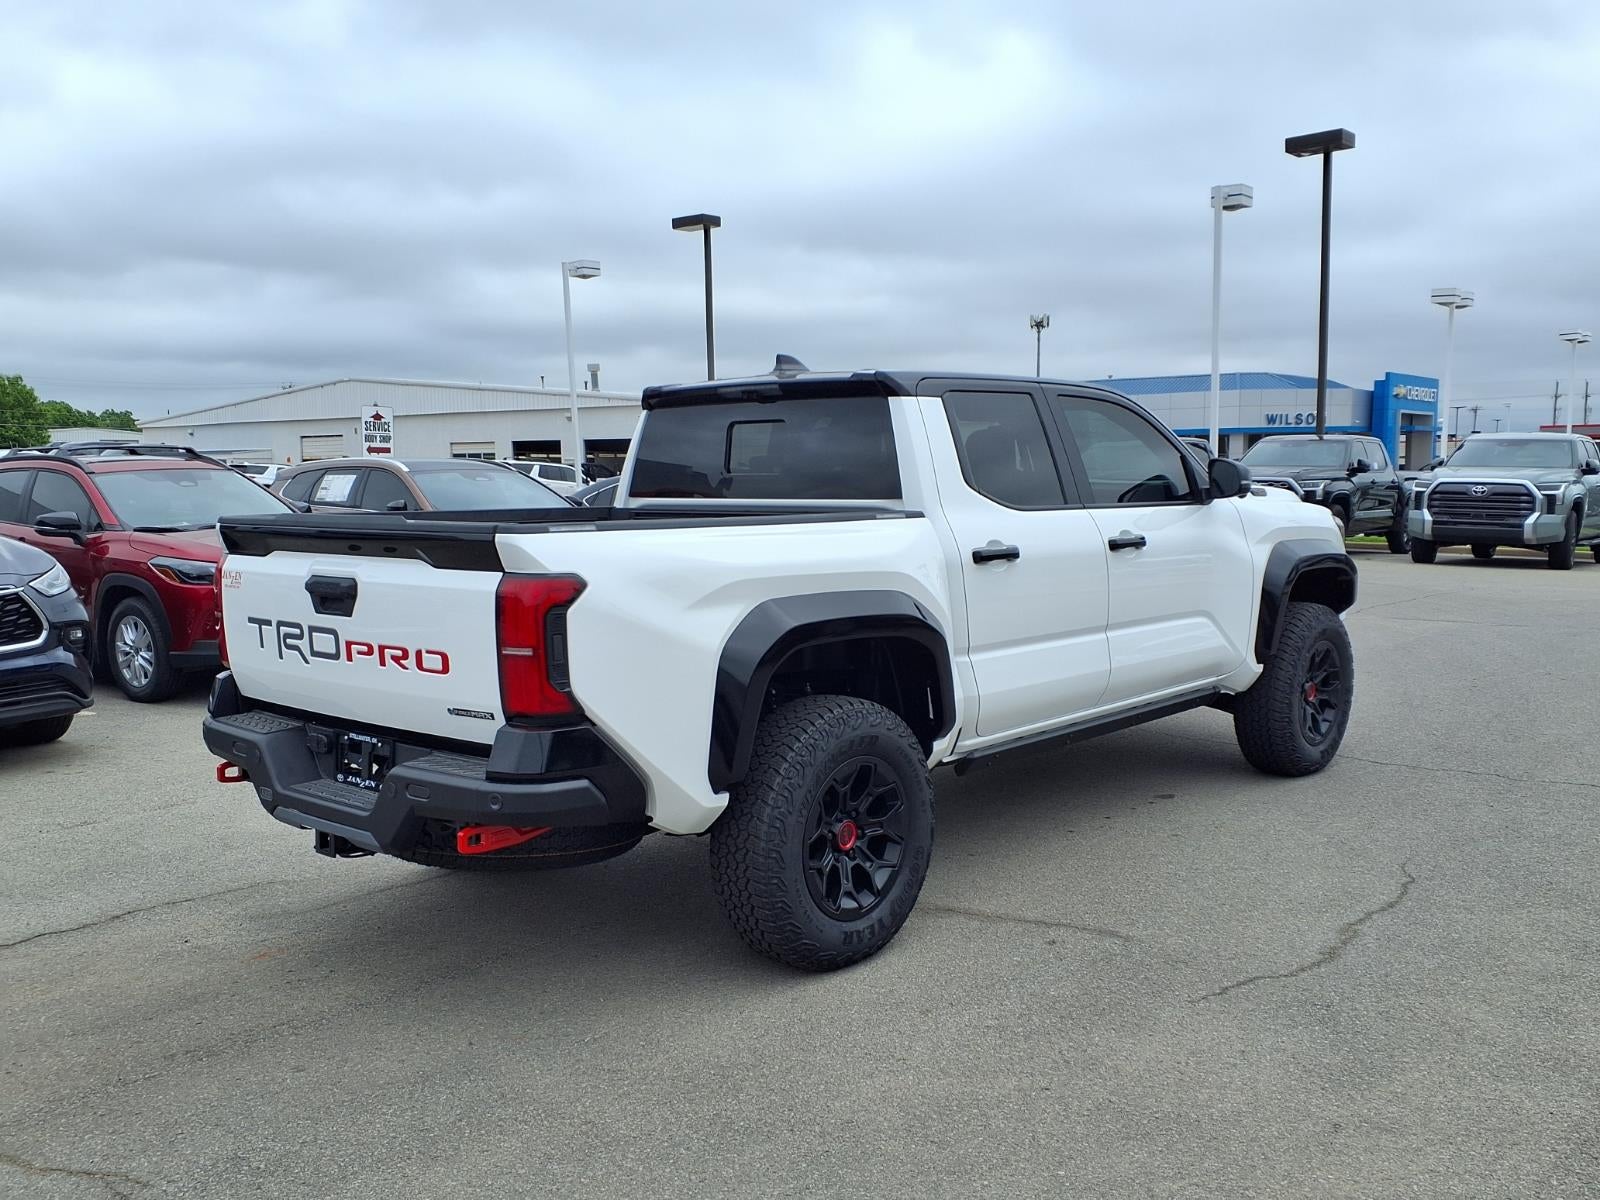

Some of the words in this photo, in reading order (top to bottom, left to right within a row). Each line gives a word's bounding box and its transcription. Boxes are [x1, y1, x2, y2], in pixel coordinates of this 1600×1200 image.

[1407, 385, 1438, 402] CHEVROLET
[1266, 412, 1317, 426] WILSO
[364, 420, 391, 432] SERVICE
[364, 433, 378, 443] BODY
[379, 434, 392, 444] SHOP
[344, 640, 450, 675] PRO
[347, 775, 377, 788] JANZEN
